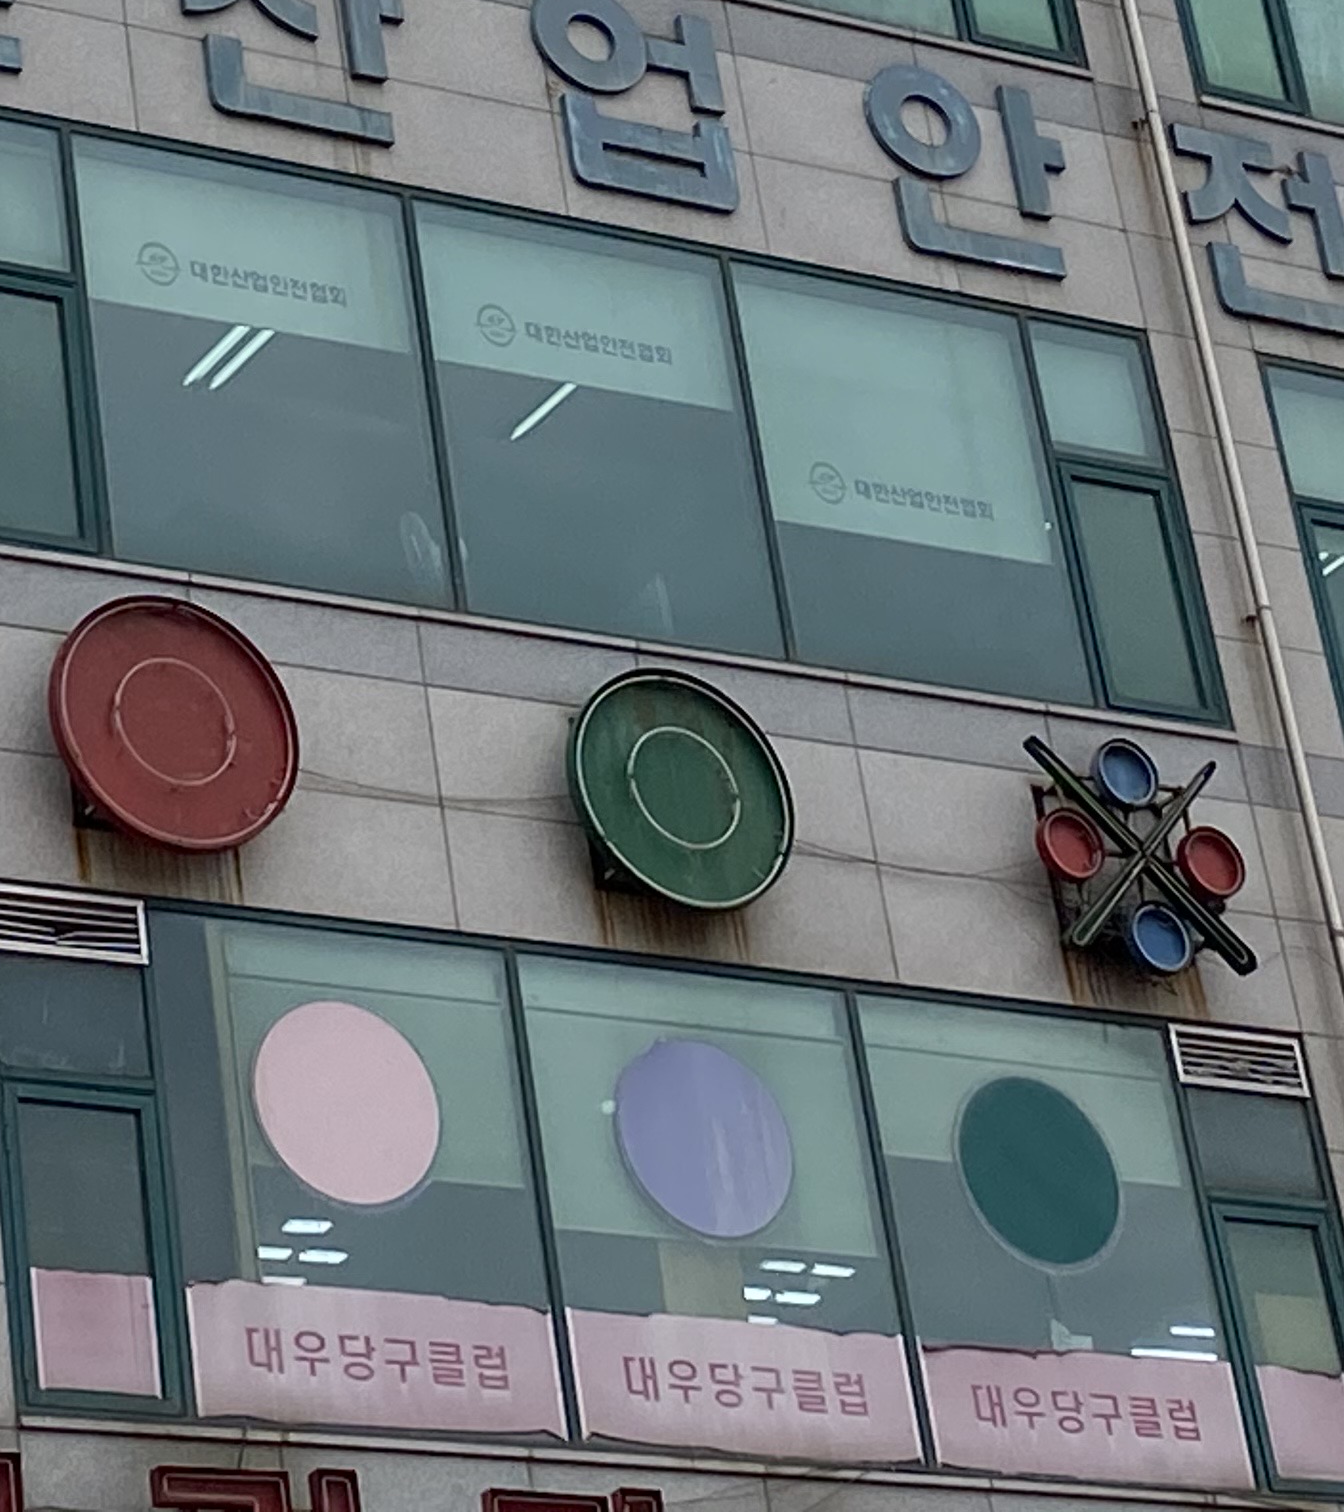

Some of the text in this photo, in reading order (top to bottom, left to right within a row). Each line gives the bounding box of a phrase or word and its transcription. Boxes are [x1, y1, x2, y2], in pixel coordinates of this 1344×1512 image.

[245, 1326, 511, 1390] 대우당구클럽
[622, 1354, 869, 1417] 대우당구클럽
[970, 1383, 1201, 1442] 대우당구클럽
